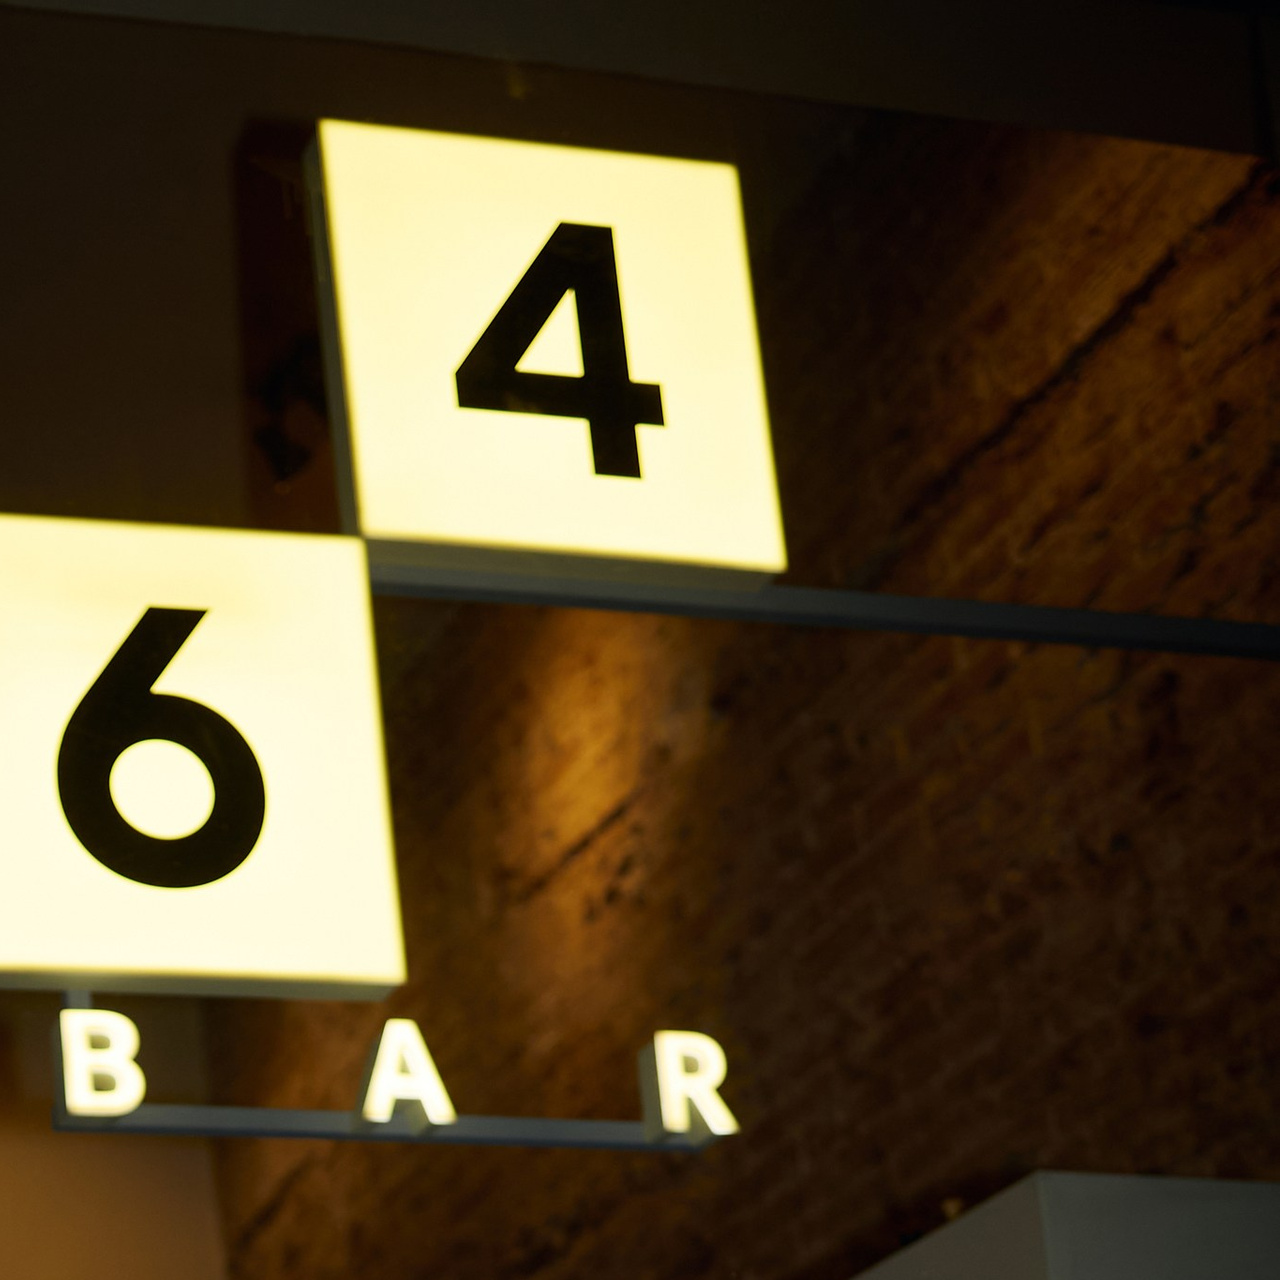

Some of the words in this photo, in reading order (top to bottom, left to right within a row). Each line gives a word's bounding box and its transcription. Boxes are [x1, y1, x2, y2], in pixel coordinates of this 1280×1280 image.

[455, 222, 665, 479] 4
[57, 607, 266, 889] 6
[61, 1009, 737, 1136] BAR
